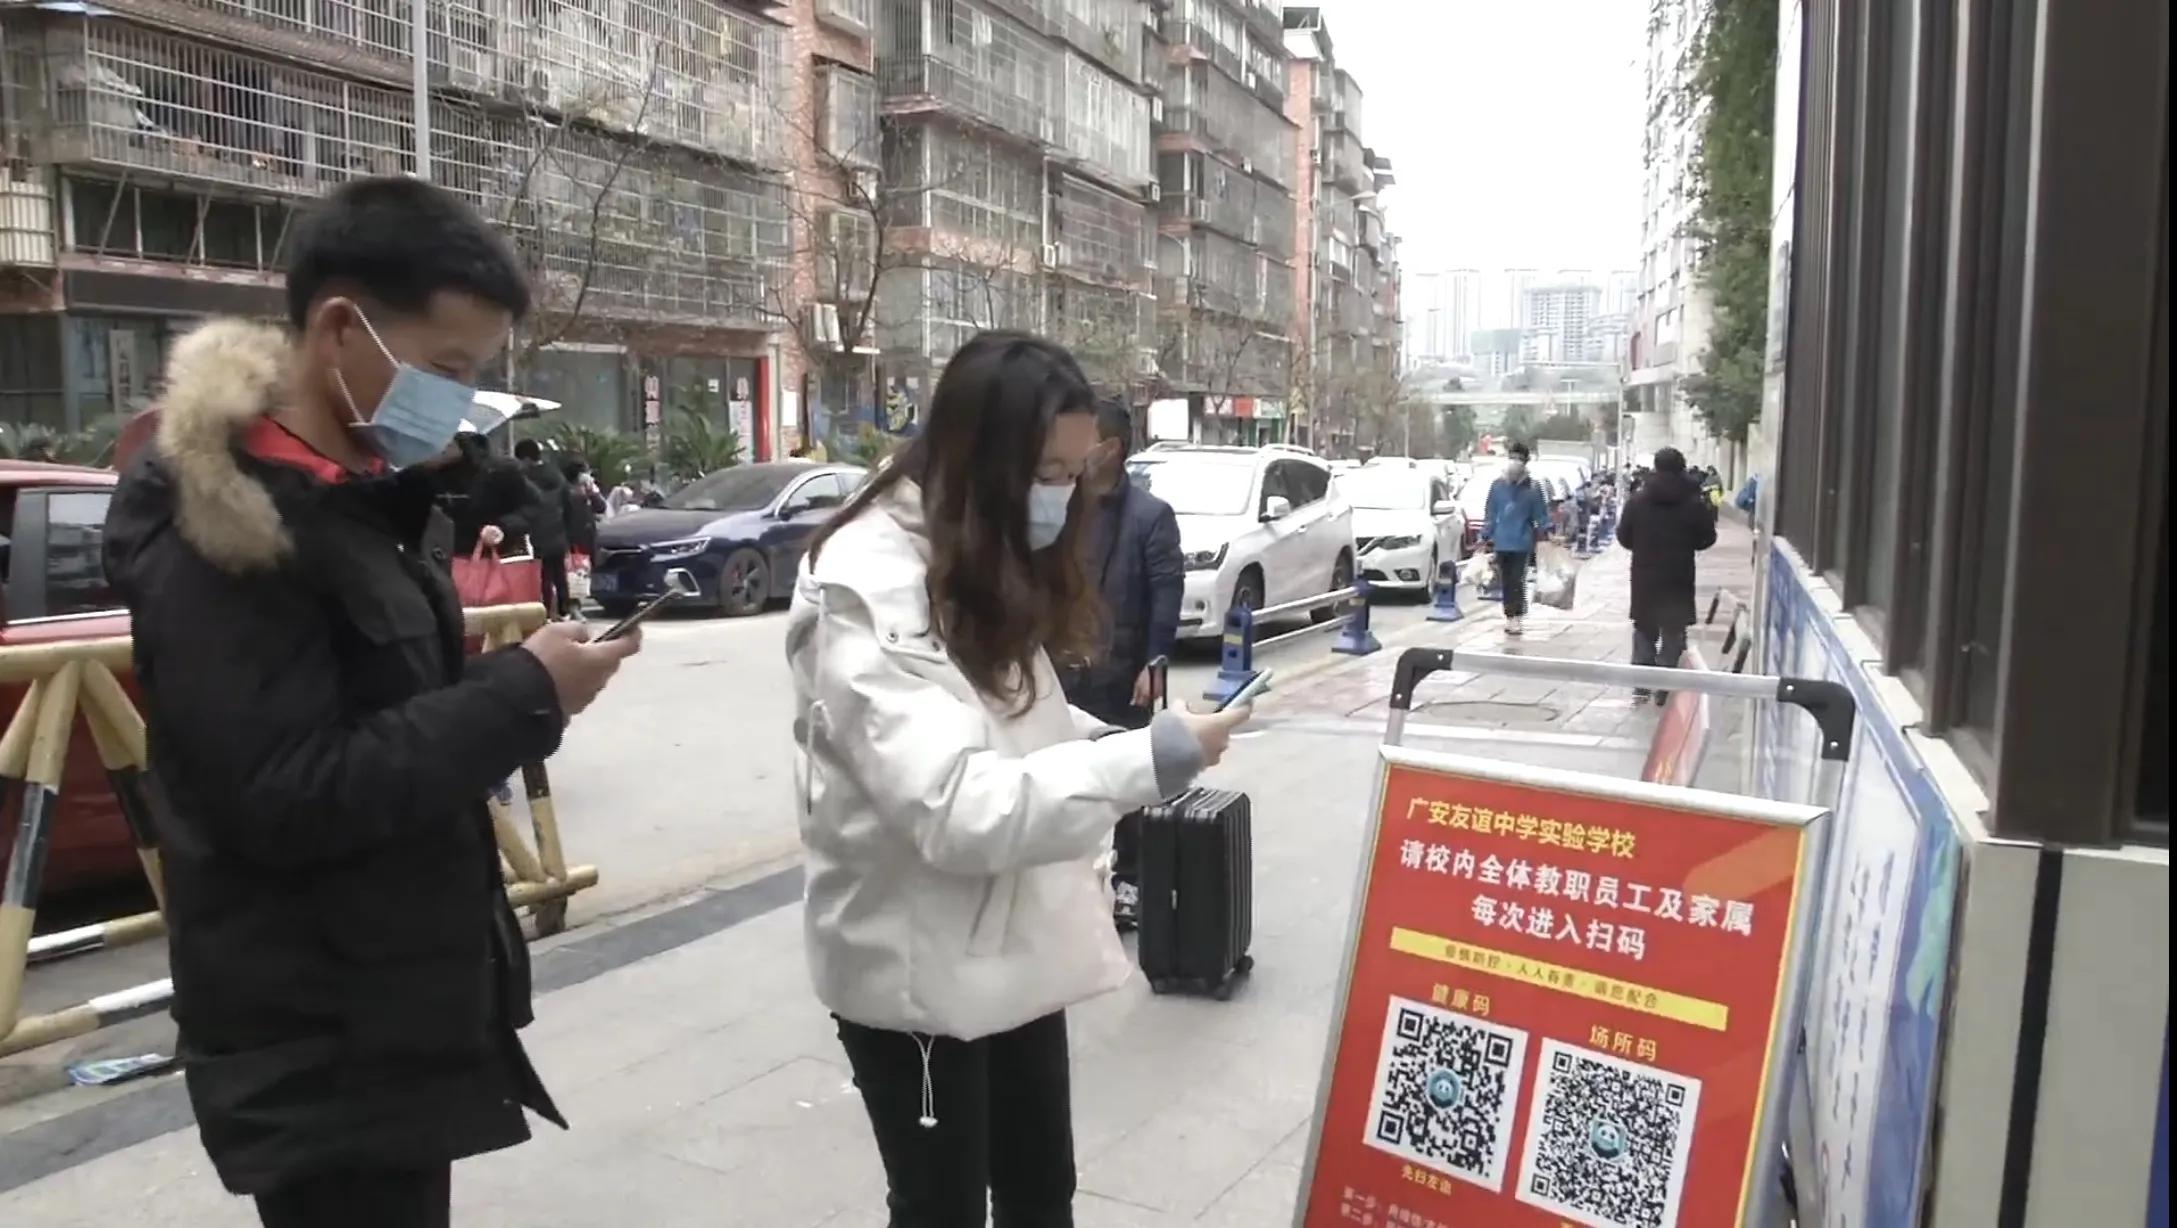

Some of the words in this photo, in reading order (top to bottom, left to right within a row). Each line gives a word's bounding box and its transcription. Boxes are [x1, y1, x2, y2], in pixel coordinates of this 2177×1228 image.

[1407, 797, 1637, 859] 广安友谊中学实验学校
[1400, 838, 1755, 937] 请校内全体教职员工及家属
[1471, 893, 1647, 961] 每次进入扫码
[1432, 982, 1490, 1016] 健康码
[1589, 1023, 1657, 1062] 场所码
